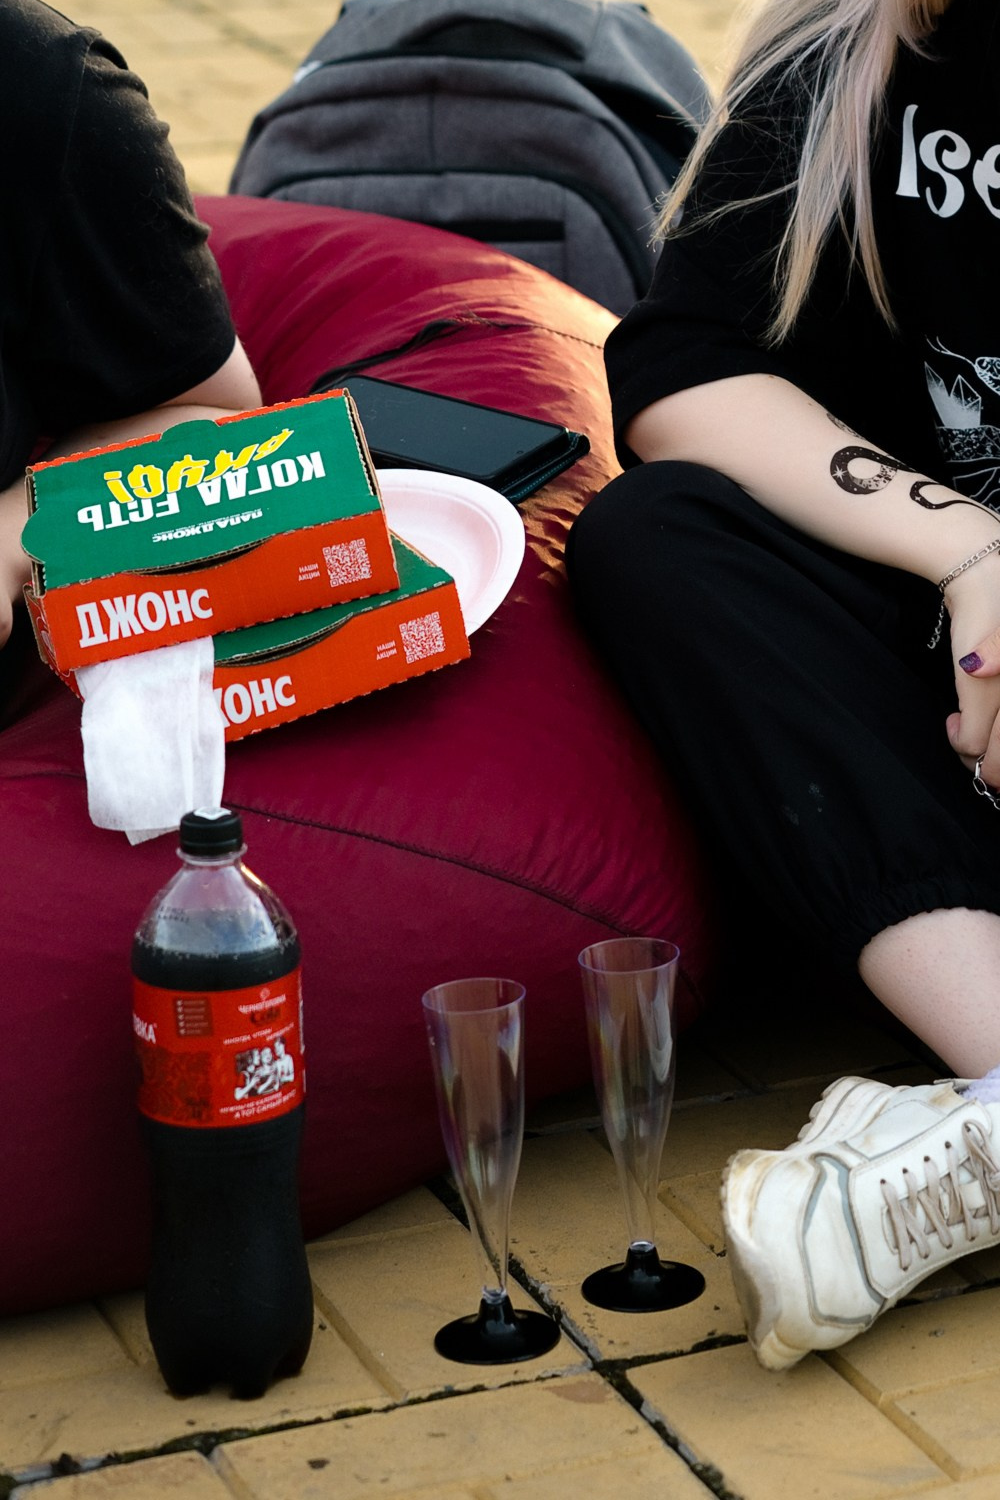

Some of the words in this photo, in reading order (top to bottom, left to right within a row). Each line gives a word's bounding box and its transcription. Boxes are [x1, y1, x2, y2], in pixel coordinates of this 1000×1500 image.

[197, 451, 326, 503] КОГДА
[77, 489, 181, 532] ЕСТЬ
[152, 523, 214, 543] ДЖОНС
[215, 509, 263, 529] ПАПА
[75, 588, 213, 648] ДЖОНС
[212, 675, 296, 728] ОНС
